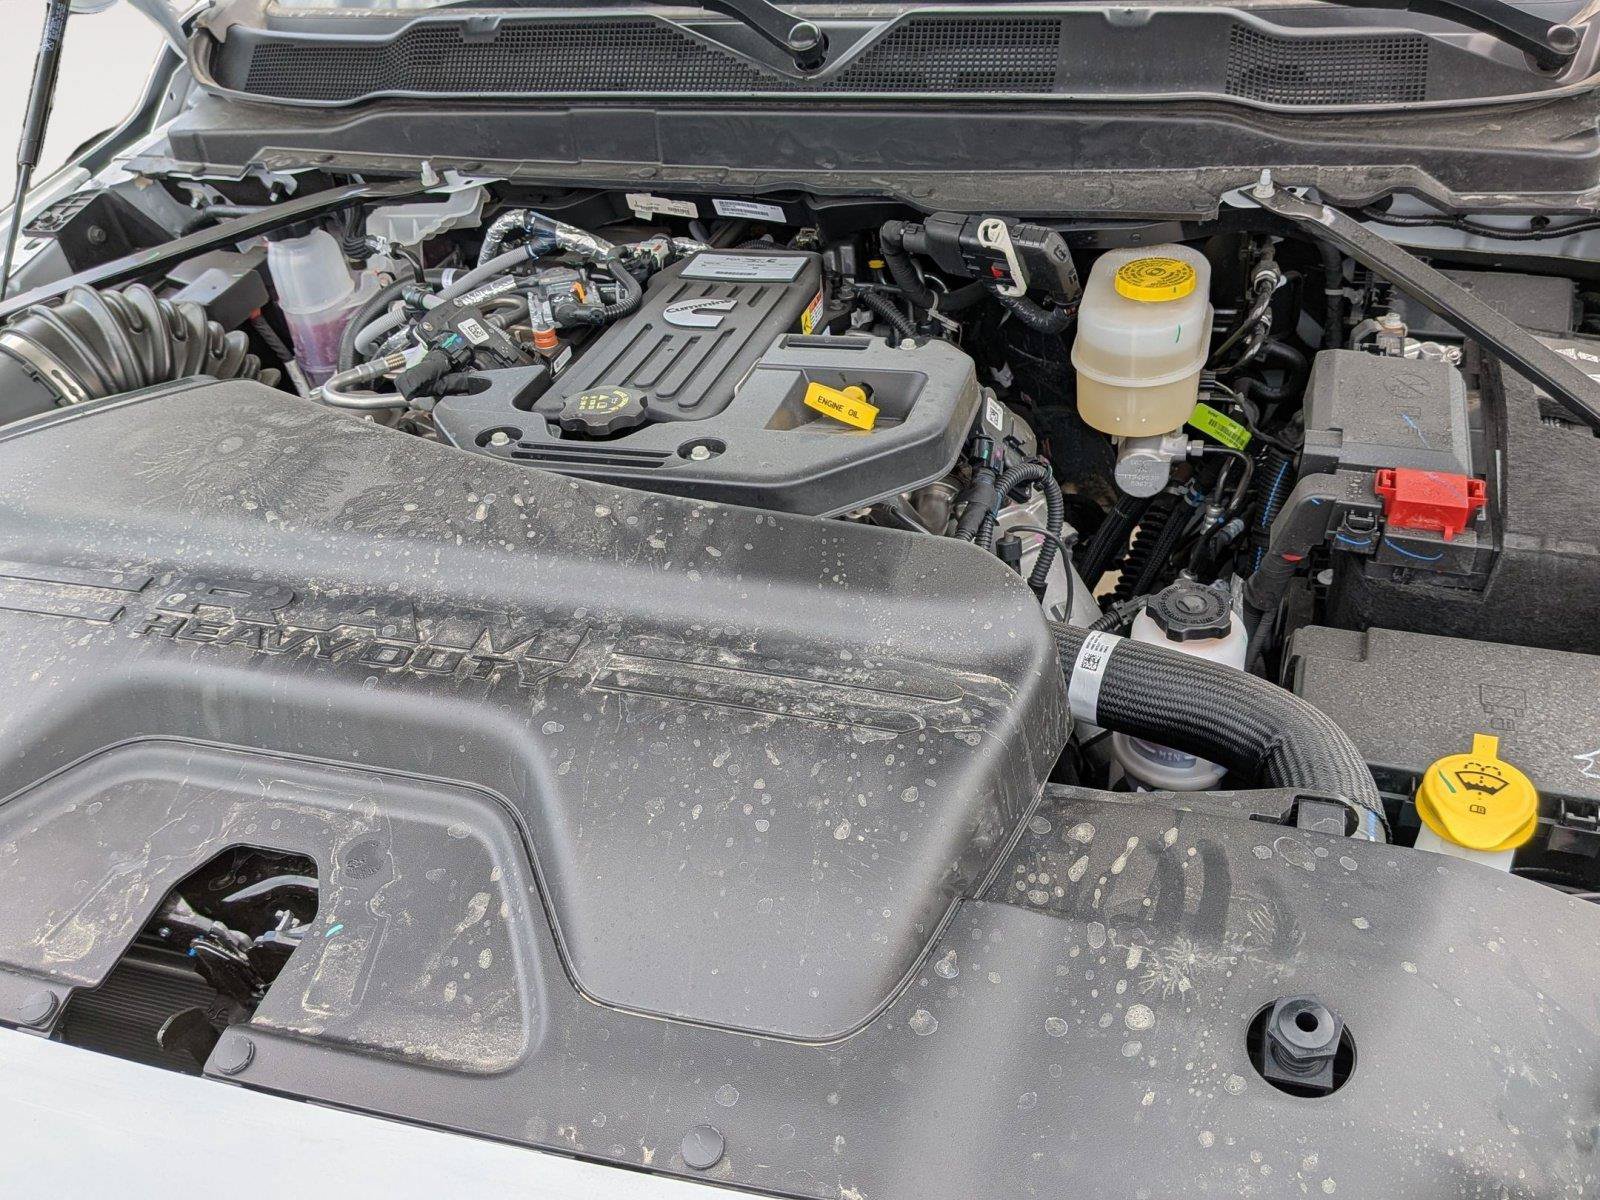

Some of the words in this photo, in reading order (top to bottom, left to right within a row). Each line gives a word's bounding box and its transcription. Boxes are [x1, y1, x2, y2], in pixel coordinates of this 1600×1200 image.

[817, 396, 845, 412] ENGINE
[847, 409, 860, 419] OIL
[155, 576, 592, 663] RAM
[134, 612, 362, 659] HEAVY
[357, 642, 570, 688] DUTY
[1158, 750, 1183, 762] MIN
